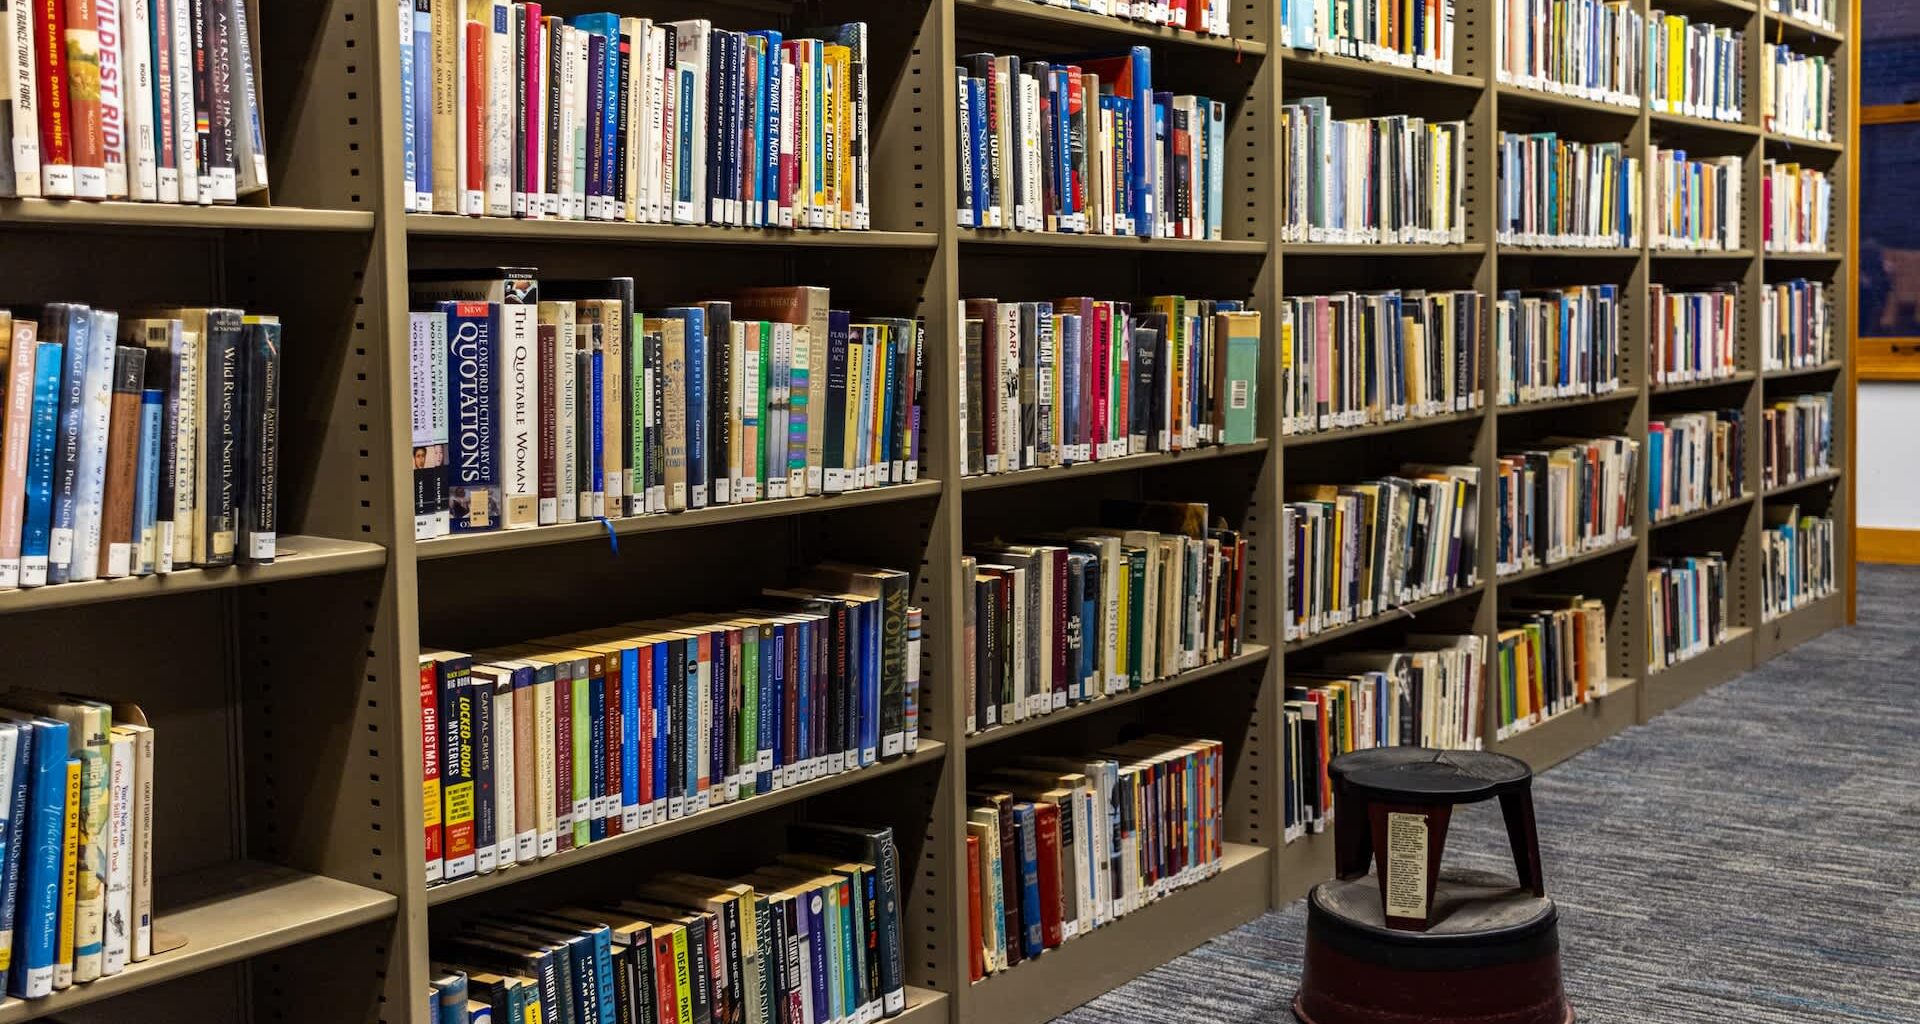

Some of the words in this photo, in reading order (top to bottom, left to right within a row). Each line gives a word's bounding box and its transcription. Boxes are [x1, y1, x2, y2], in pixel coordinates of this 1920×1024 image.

[16, 9, 30, 67] FRANCE/TOUR
[48, 23, 58, 66] DIARIES
[179, 42, 189, 56] OF
[196, 20, 205, 48] Karate
[237, 8, 250, 61] TECHNIQUES
[197, 50, 205, 72] Bible
[244, 62, 252, 70] &
[403, 49, 412, 73] The
[771, 44, 780, 65] Writing
[19, 70, 30, 81] DE
[51, 76, 60, 108] DAVID
[219, 13, 229, 93] AMERICAN
[224, 100, 233, 162] SHAOLIN
[245, 72, 255, 107] TACTICS
[666, 72, 675, 108] WRITING
[959, 76, 968, 109] LEM
[20, 83, 31, 110] FORCE
[182, 91, 192, 133] KWON
[404, 81, 412, 144] Invisible
[653, 77, 663, 130] Fiction
[770, 77, 780, 113] PRIVATE
[988, 60, 999, 129] THRILLERS
[53, 112, 62, 146] BYRNE
[102, 104, 120, 164] RIDE
[666, 111, 674, 125] THE
[770, 117, 779, 133] EYE
[183, 139, 192, 160] DO
[770, 138, 779, 167] NOVEL
[826, 135, 834, 161] MIC
[961, 110, 971, 192] MICROWORLDS
[980, 129, 989, 194] NABOKOV
[990, 135, 999, 156] 100
[479, 323, 488, 346] THE
[515, 308, 527, 339] THE
[564, 322, 573, 348] FIRST
[1009, 310, 1017, 359] SHARP
[1040, 311, 1052, 340] STILL
[18, 328, 32, 368] Quiet
[73, 328, 84, 377] VOYAGE
[103, 334, 112, 374] HELL
[224, 347, 235, 379] Wild
[565, 352, 573, 376] LOVE
[811, 333, 822, 398] THEATRE
[1041, 342, 1052, 363] MAD
[180, 341, 188, 434] CHRISTINE
[480, 348, 488, 394] OXFORD
[514, 346, 528, 425] QUOTABLE
[16, 371, 30, 412] Water
[45, 376, 57, 420] Rowing
[72, 380, 82, 404] FOR
[223, 382, 234, 420] Rivers
[451, 322, 479, 482] QUOTATIONS
[565, 379, 574, 418] STORIES
[635, 375, 643, 416] beloved
[45, 428, 53, 439] to
[68, 408, 80, 462] MADMEN
[97, 414, 106, 455] HIGH
[169, 416, 178, 439] Kayak
[224, 423, 234, 434] of
[267, 407, 275, 443] PADDLE
[480, 395, 489, 464] DICTIONARY
[635, 419, 641, 434] on
[41, 448, 53, 502] Latitude
[168, 442, 177, 488] Companion
[223, 440, 233, 480] North
[481, 466, 489, 480] OF
[516, 431, 527, 493] WOMAN
[64, 469, 74, 495] Peter
[93, 466, 102, 517] WATER
[179, 448, 187, 513] JEROME
[883, 588, 901, 695] WOMEN
[481, 691, 489, 733] CAPITAL
[424, 707, 437, 775] CHRISTMAS
[448, 721, 459, 777] MYSTERIES
[459, 696, 471, 778] LOCKED-ROOM
[71, 773, 79, 807] DOGS
[113, 768, 121, 785] You
[15, 784, 27, 829] PUPPIES,
[120, 785, 129, 810] You're
[70, 813, 78, 828] ON
[112, 821, 120, 834] See
[120, 812, 128, 829] Not
[11, 830, 23, 860] DOGS,
[69, 835, 77, 857] THE
[111, 850, 119, 872] Truck
[11, 862, 20, 880] and
[67, 864, 75, 898] TRAIL
[880, 839, 893, 892] ROGUES
[7, 883, 18, 903] Blue
[41, 883, 56, 909] Gary
[43, 912, 54, 948] Paulsen
[763, 909, 772, 956] TALES
[545, 965, 556, 1002] INHERIT
[599, 944, 610, 1008] KILLER
[677, 952, 686, 986] DEATH
[732, 962, 740, 998] WEIRD
[757, 945, 767, 992] MODERN
[588, 969, 596, 1009] OCCURS
[548, 1005, 557, 1023] THE
